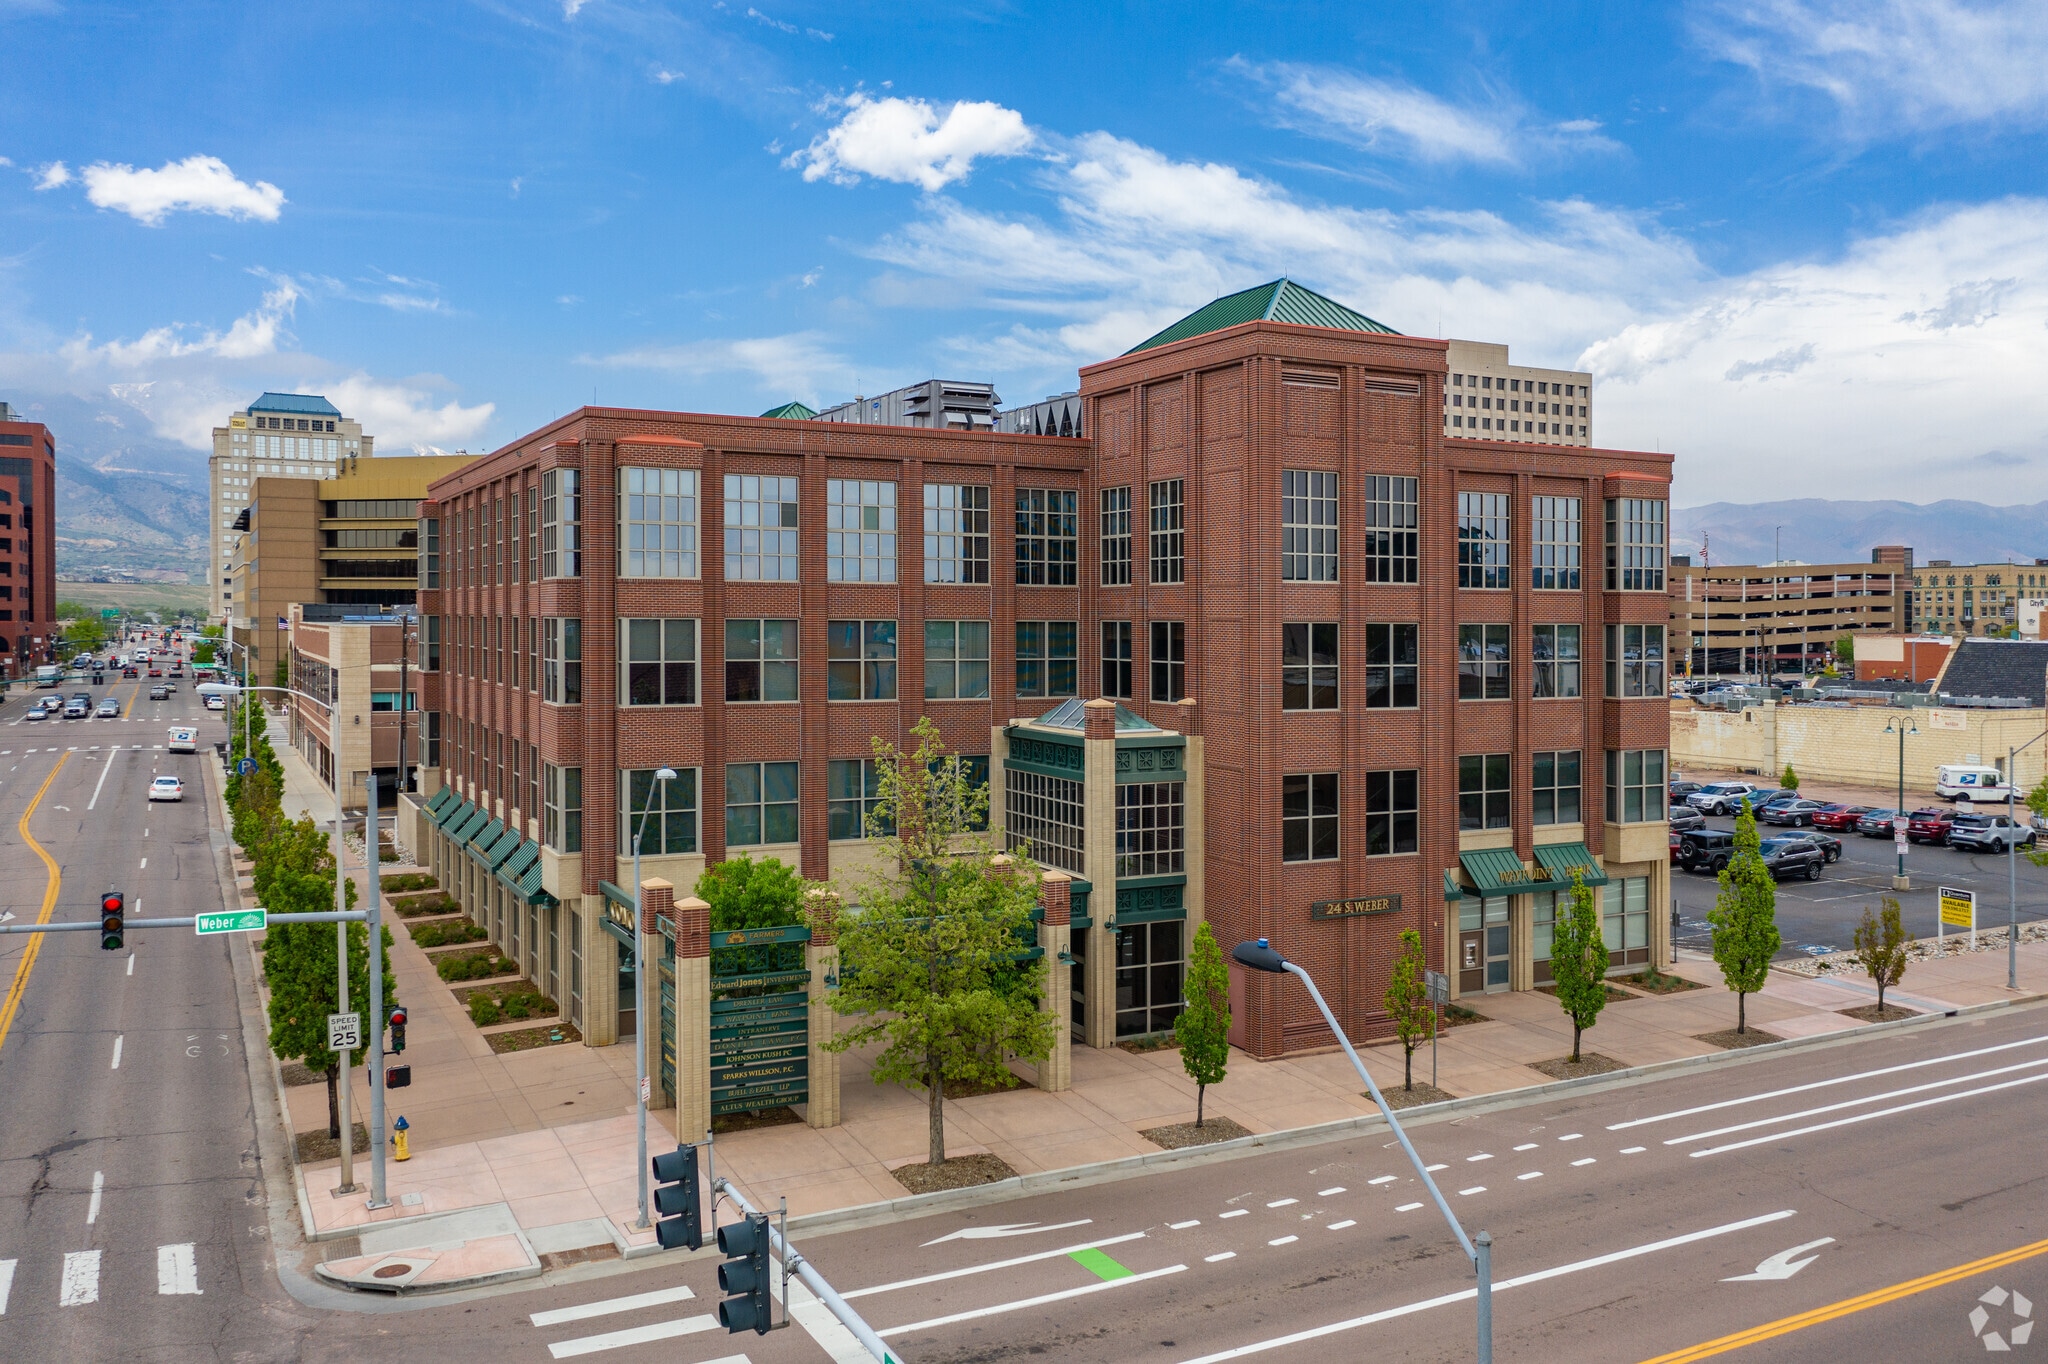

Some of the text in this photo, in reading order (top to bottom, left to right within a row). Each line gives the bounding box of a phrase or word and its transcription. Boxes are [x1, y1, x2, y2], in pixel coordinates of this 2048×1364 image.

[242, 760, 251, 772] P
[1498, 866, 1555, 883] WAYPOINT
[1326, 898, 1390, 915] 24 S. WEBER
[1942, 900, 1969, 908] AVAILABLE
[200, 916, 235, 930] Weber
[749, 930, 785, 938] FARMERS
[711, 974, 811, 990] Edward Jones INVESTMENTS
[733, 996, 784, 1008] DREXLER LAW
[330, 1016, 358, 1024] SPEED
[724, 1010, 790, 1022] WAYPOINT BANK
[334, 1024, 354, 1032] LIMIT
[332, 1032, 356, 1046] 25
[725, 1052, 761, 1064] JOHNSON
[762, 1050, 782, 1059] KUSH
[722, 1072, 748, 1081] SPARKS
[748, 1068, 782, 1077] WILLSON,
[728, 1089, 747, 1097] BUELL
[778, 1083, 791, 1091] LLP
[720, 1096, 800, 1112] ALTUS WEALTH GROUP
